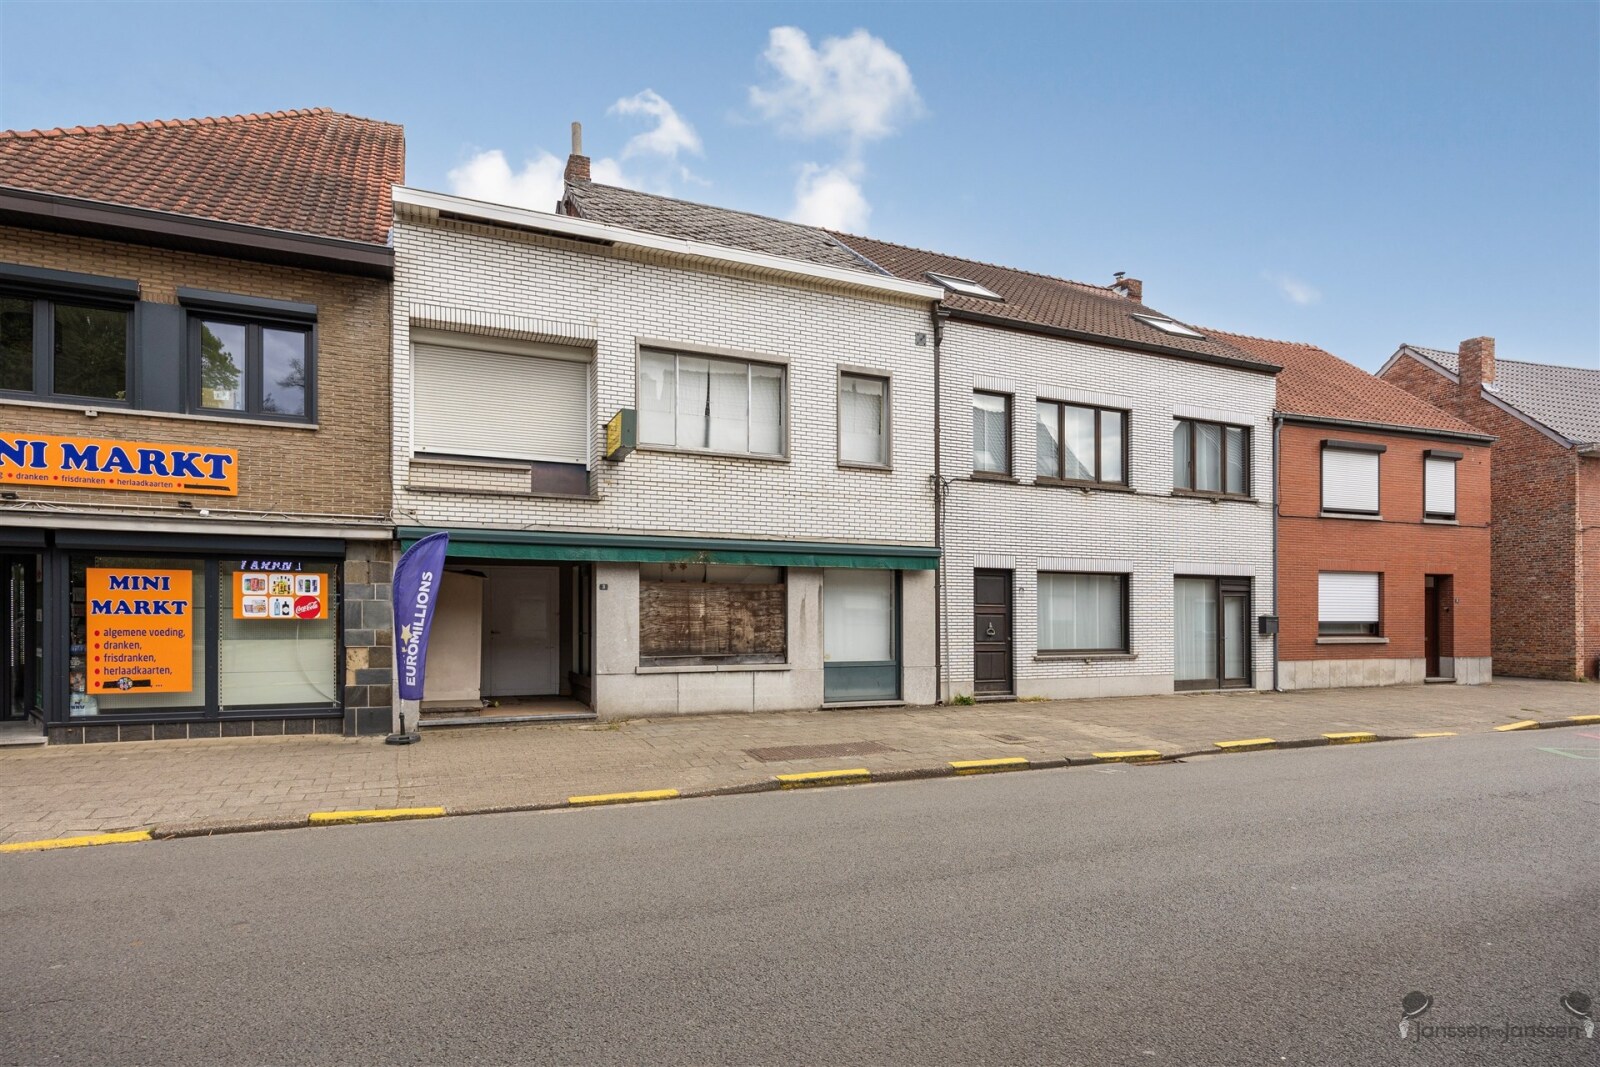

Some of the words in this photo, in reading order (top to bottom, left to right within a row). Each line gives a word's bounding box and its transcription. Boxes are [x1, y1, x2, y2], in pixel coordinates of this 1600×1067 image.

[60, 442, 233, 480] MARKT
[16, 473, 49, 481] dranken
[61, 475, 106, 485] frisdranken
[116, 478, 174, 488] herlaadkaarten
[109, 575, 171, 591] MINI
[91, 599, 189, 616] MARKT
[103, 628, 147, 639] algemene
[149, 628, 186, 639] voeding,
[406, 571, 433, 687] EUROMILLIONS
[103, 641, 142, 650] dranken,
[103, 653, 157, 663] frisdranken,
[103, 666, 173, 676] herlaadkaarten,
